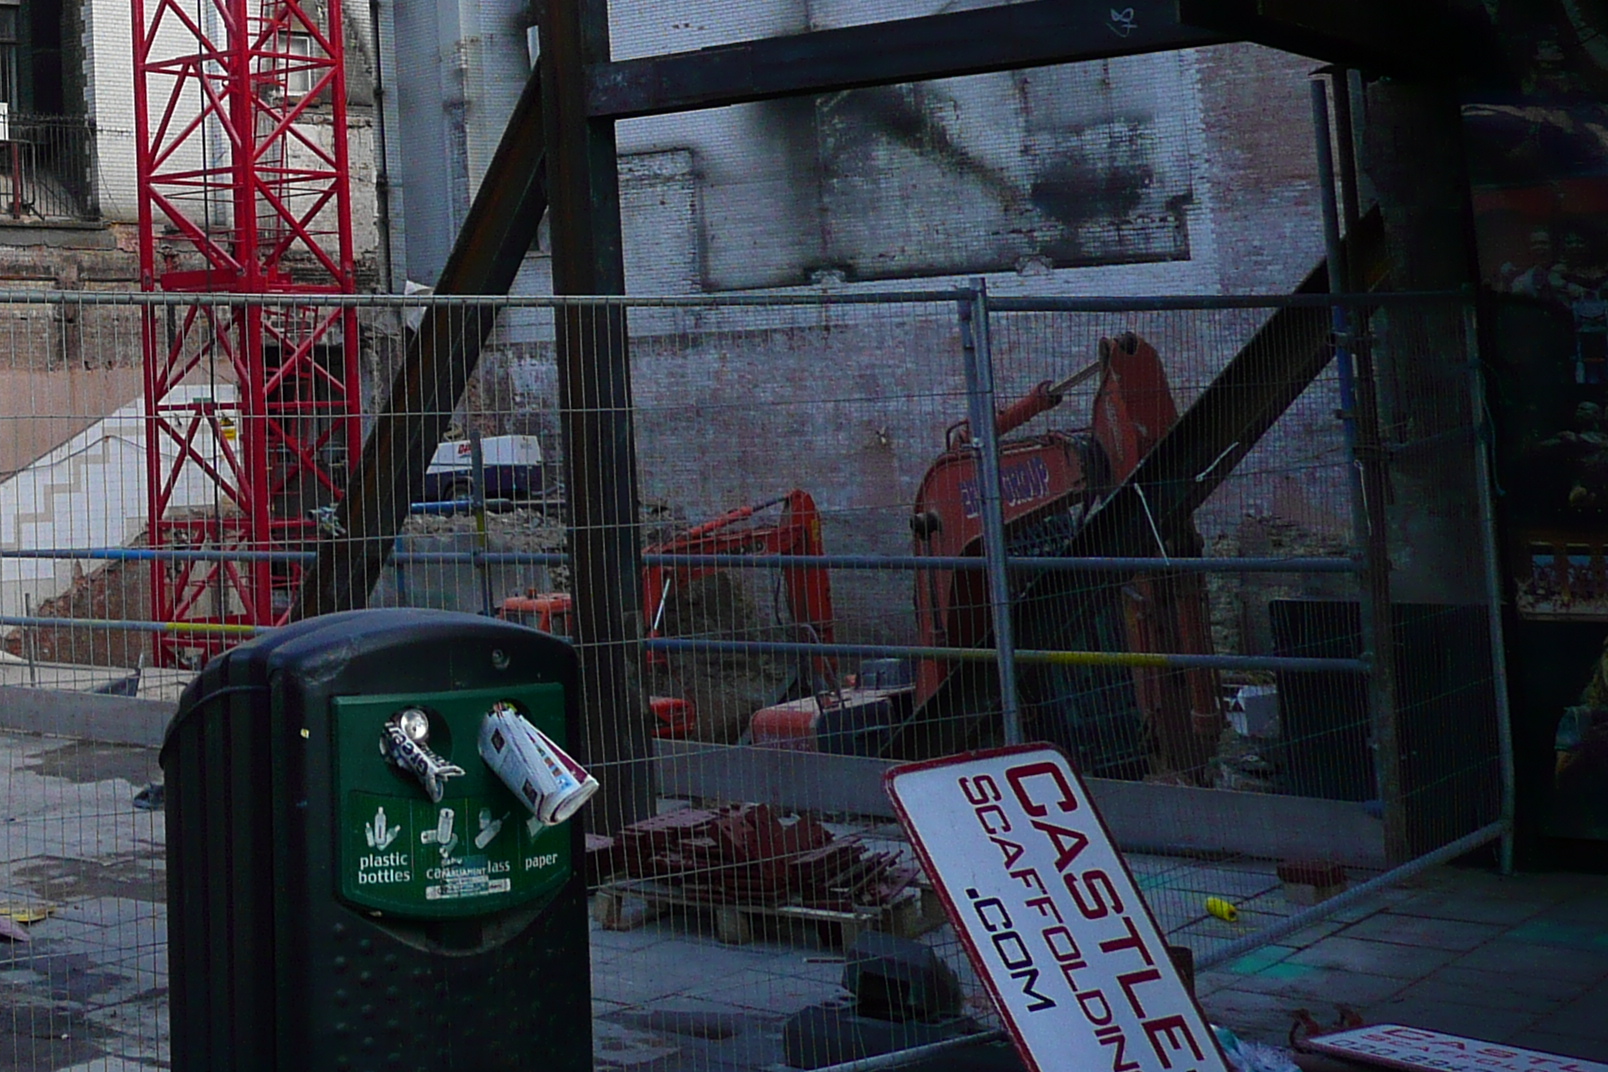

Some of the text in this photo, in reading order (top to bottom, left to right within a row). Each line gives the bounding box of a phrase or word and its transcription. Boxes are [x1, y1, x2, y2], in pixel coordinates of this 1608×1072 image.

[360, 852, 408, 869] plastic
[487, 860, 511, 874] lass
[525, 853, 558, 871] paper
[358, 869, 411, 884] bottles
[958, 775, 1141, 1072] SCAFFOLDIN
[1005, 762, 1205, 1070] CASTLE
[965, 888, 1057, 1012] .COM
